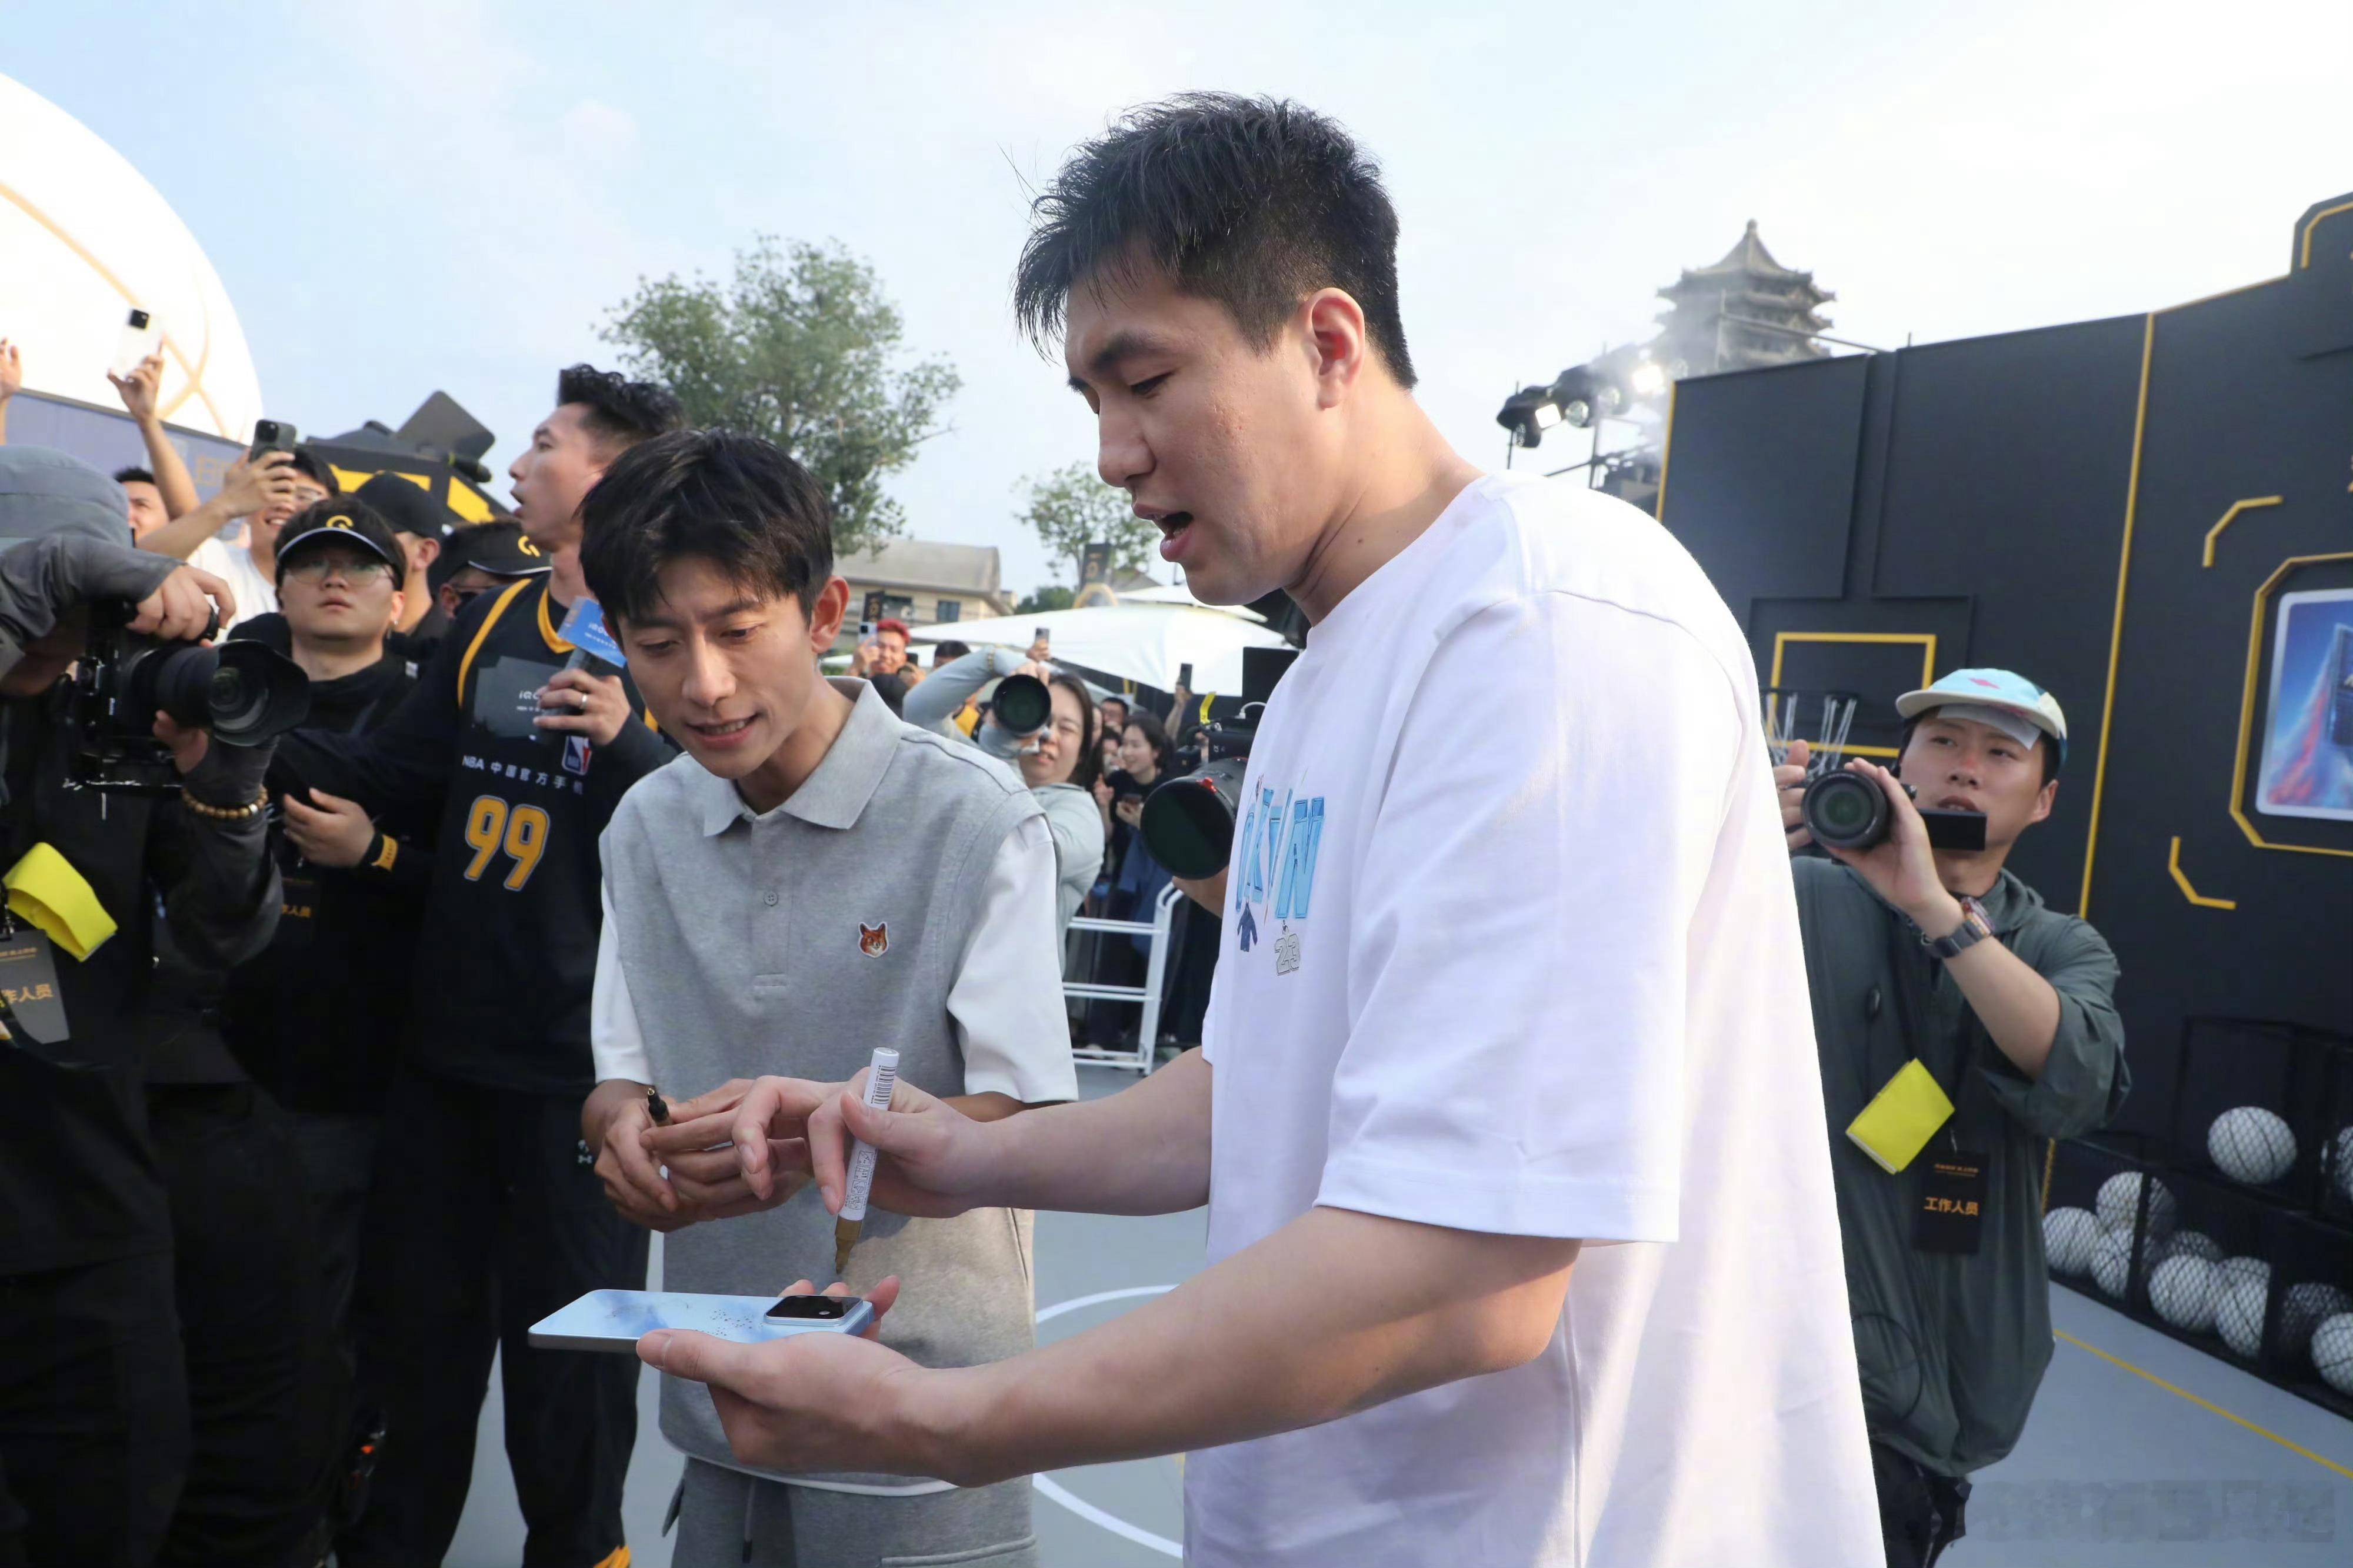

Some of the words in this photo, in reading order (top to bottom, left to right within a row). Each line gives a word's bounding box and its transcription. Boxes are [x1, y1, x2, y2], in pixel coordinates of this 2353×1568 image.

[464, 795, 551, 892] 99
[1274, 933, 1301, 977] 23
[1923, 1196, 1979, 1216] 工作人员
